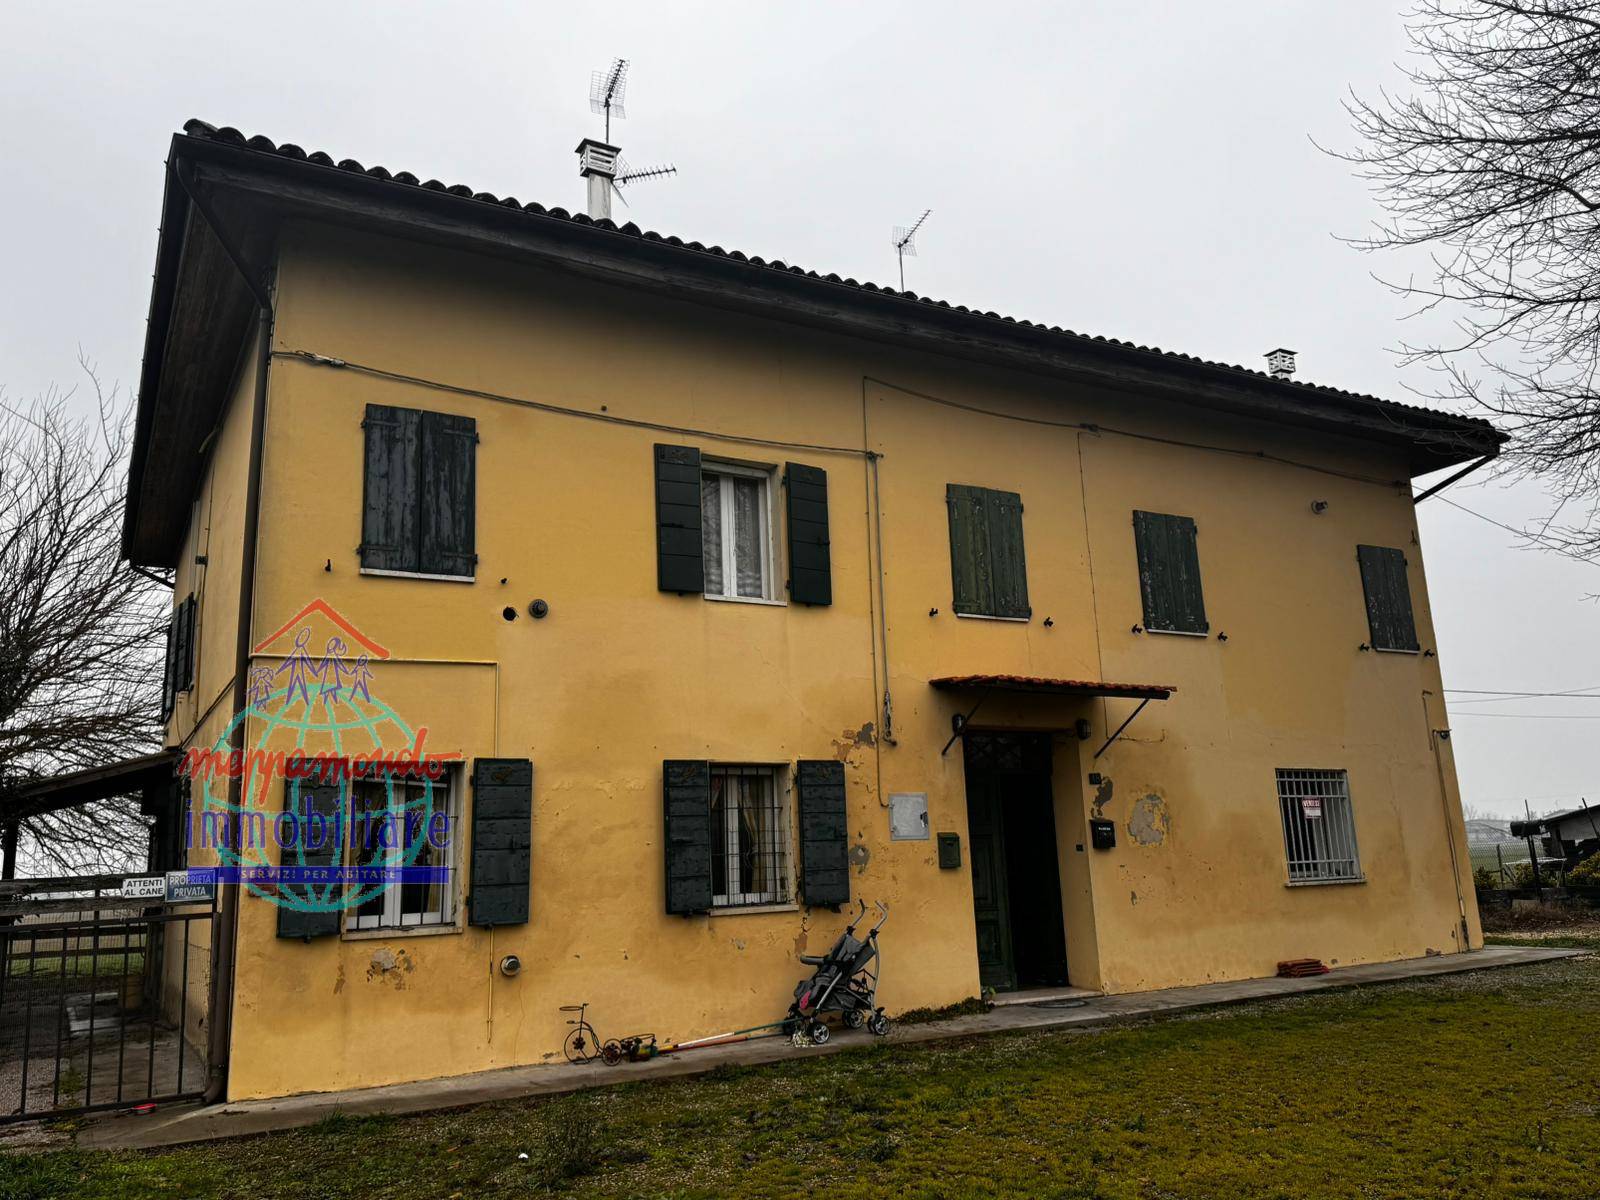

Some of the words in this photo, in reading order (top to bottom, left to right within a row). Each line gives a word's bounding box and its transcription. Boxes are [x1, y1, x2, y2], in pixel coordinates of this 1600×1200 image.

[126, 878, 163, 889] ATTENTI
[124, 888, 137, 897] AL
[138, 887, 164, 896] CANE
[173, 886, 207, 898] PRIVATA
